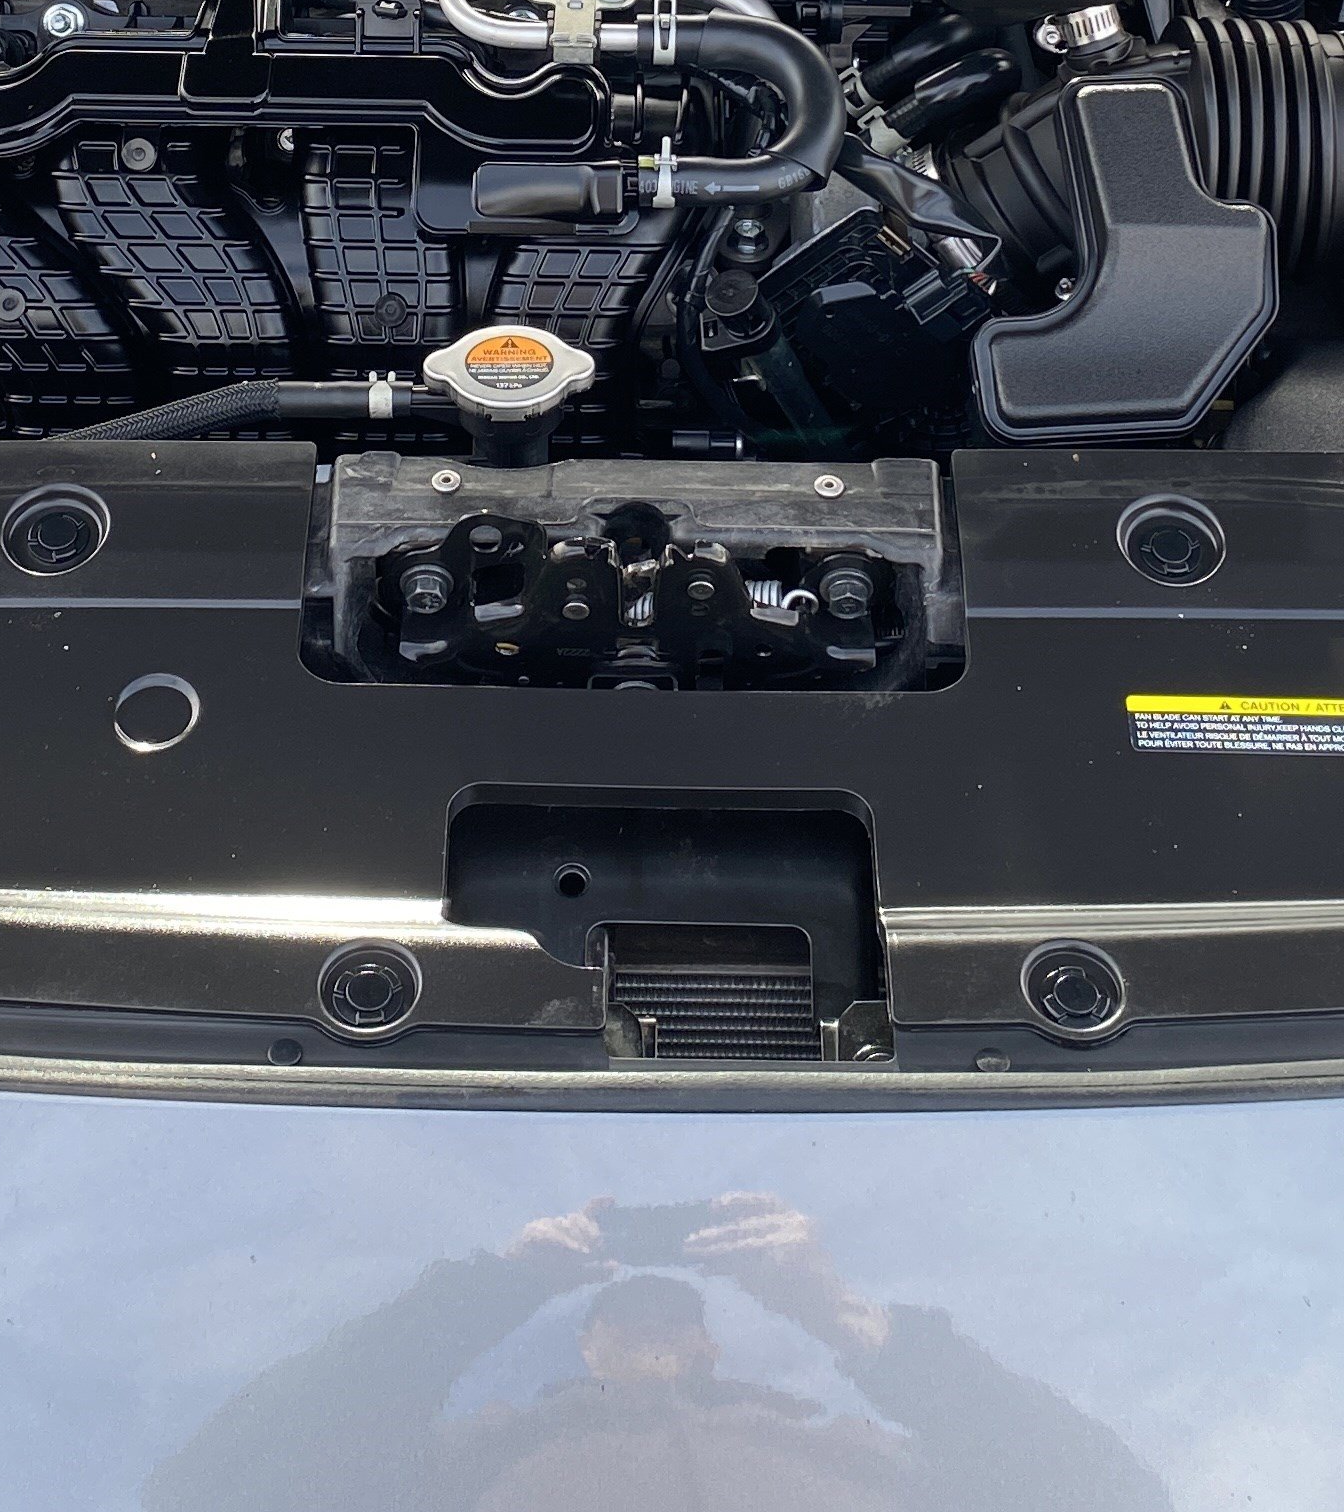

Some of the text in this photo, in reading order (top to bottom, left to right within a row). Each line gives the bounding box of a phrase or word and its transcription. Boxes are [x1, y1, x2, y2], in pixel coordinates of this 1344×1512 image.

[1240, 701, 1299, 712] CAUTION
[1200, 723, 1246, 731] PERSONAL
[1150, 731, 1204, 740] VENTILATEUR
[1205, 732, 1238, 740] RISQUE
[1253, 732, 1299, 742] DÉMARRER
[1165, 739, 1194, 748] ÉVITER
[1194, 740, 1222, 748] TOUTE
[1225, 741, 1271, 750] BLESSURE,
